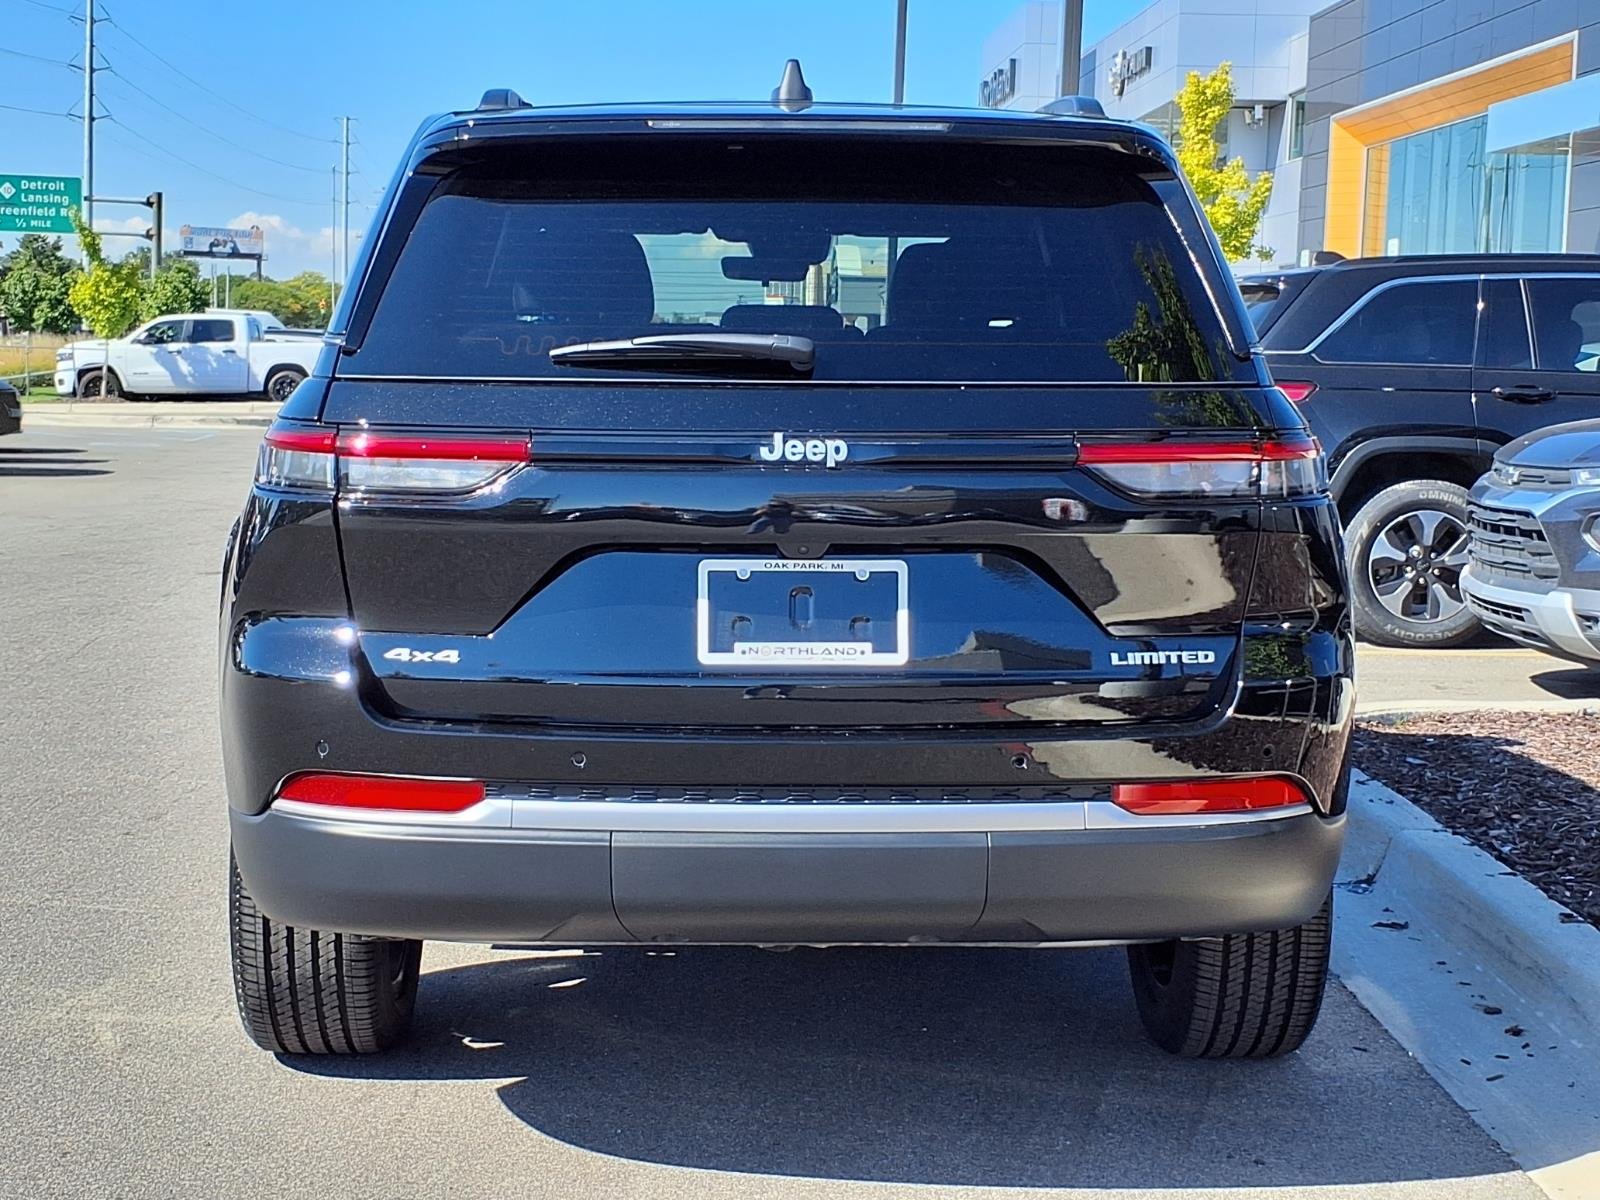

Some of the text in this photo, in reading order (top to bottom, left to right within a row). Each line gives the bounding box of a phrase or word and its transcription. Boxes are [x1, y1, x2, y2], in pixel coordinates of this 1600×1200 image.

[20, 180, 65, 191] Detroit
[20, 193, 69, 206] Lansing
[0, 206, 56, 217] reenfield
[30, 220, 52, 228] MILE
[759, 431, 848, 467] Jeep
[383, 647, 461, 664] 4x4
[748, 646, 858, 657] NORTHLAND
[1110, 650, 1215, 666] LIMITED
